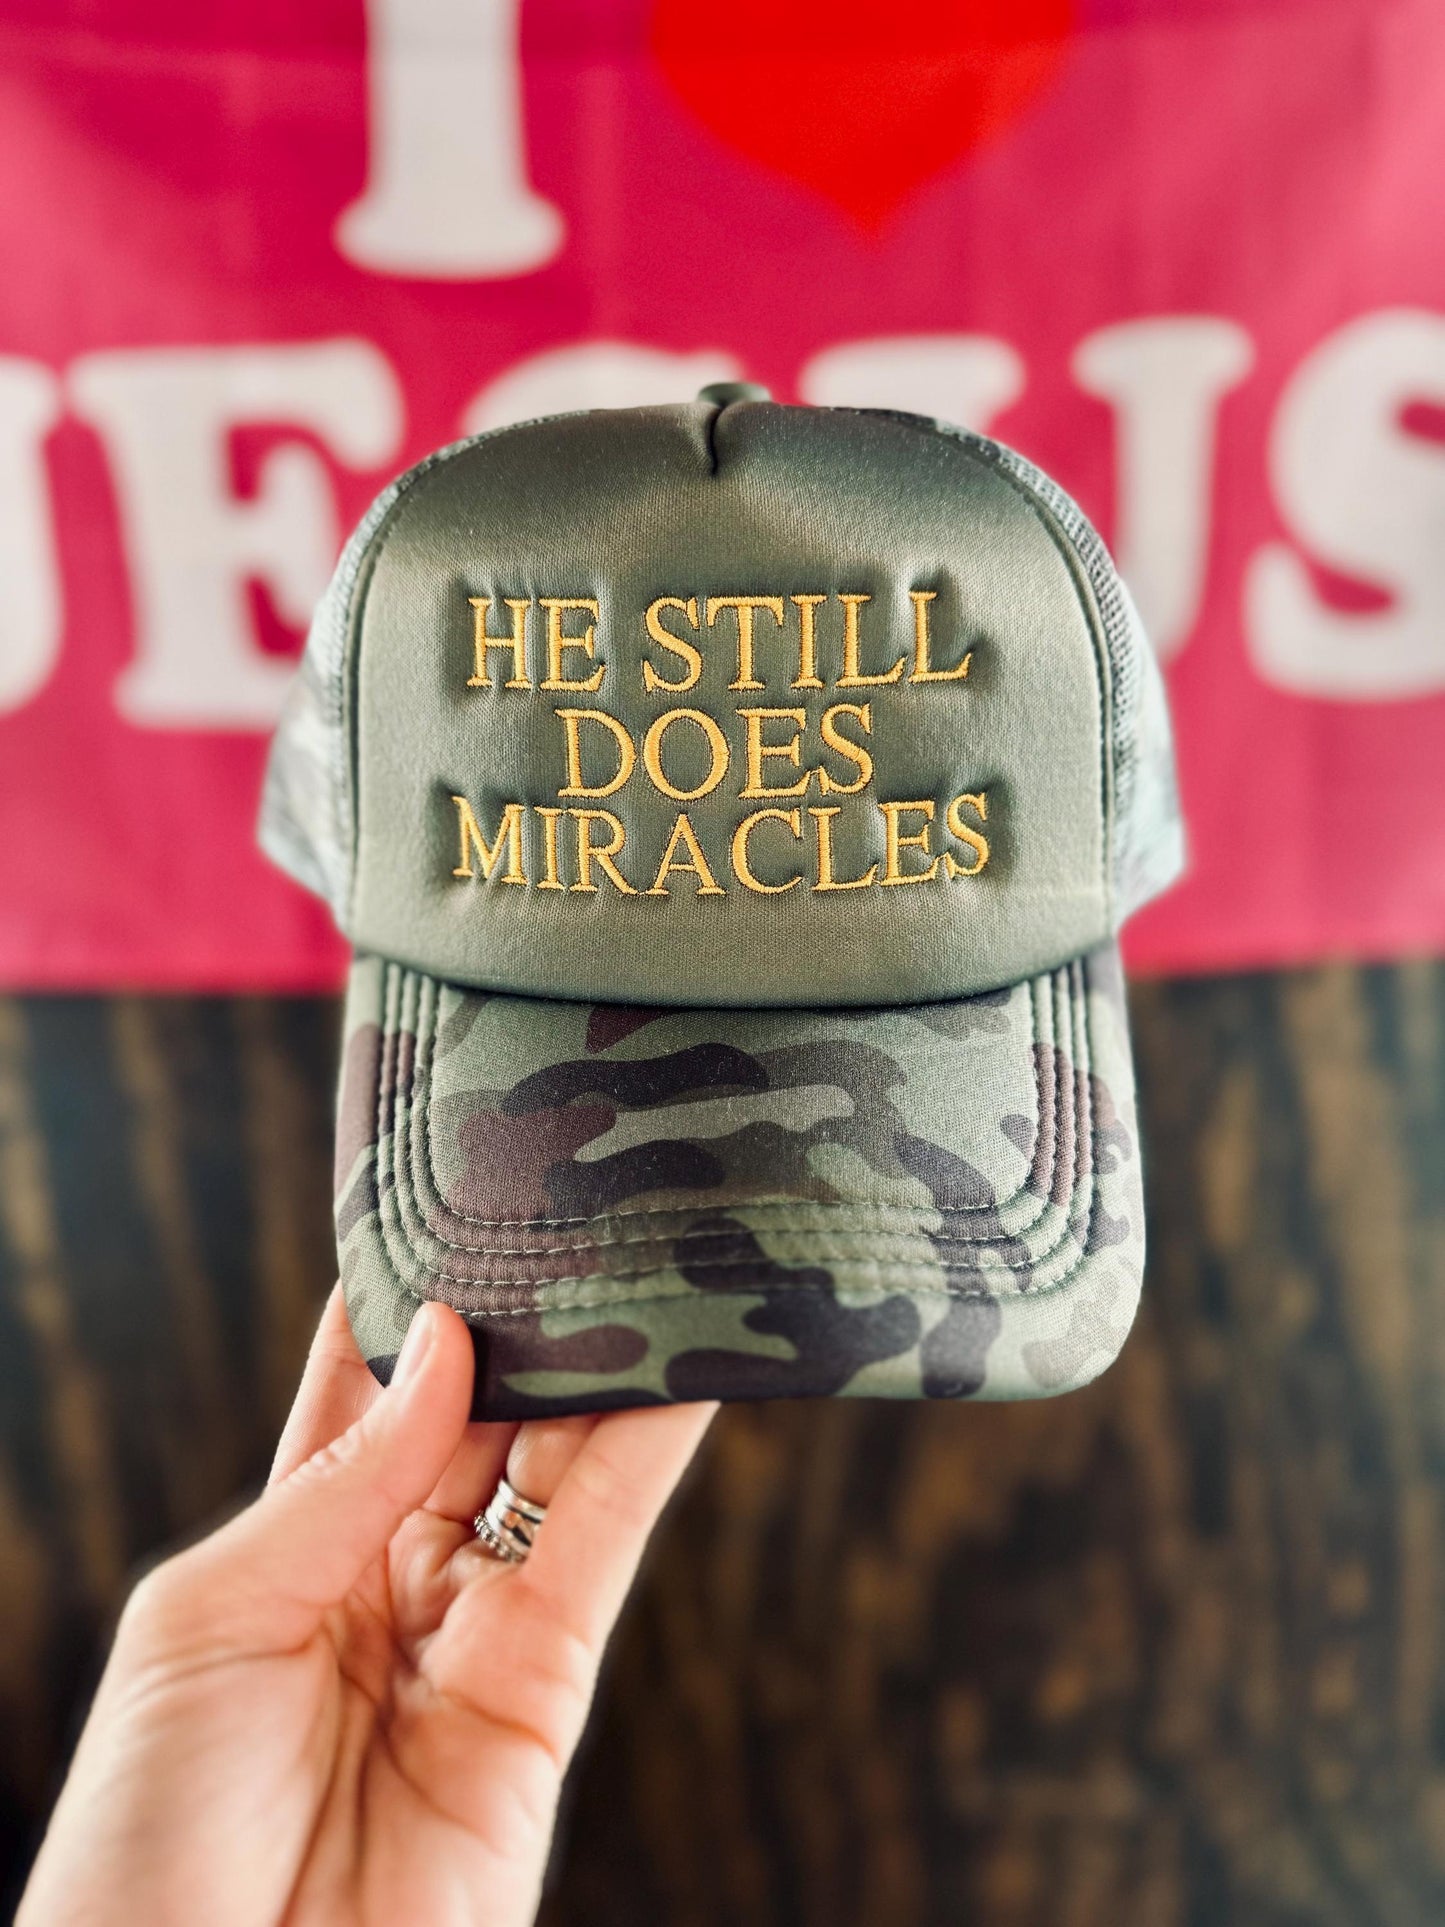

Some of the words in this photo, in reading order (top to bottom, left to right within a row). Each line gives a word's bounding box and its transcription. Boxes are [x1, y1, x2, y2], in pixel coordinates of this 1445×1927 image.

[468, 597, 606, 692] HE
[642, 591, 972, 693] STILL
[555, 703, 874, 801] DOES
[452, 793, 992, 897] MIRACLES
